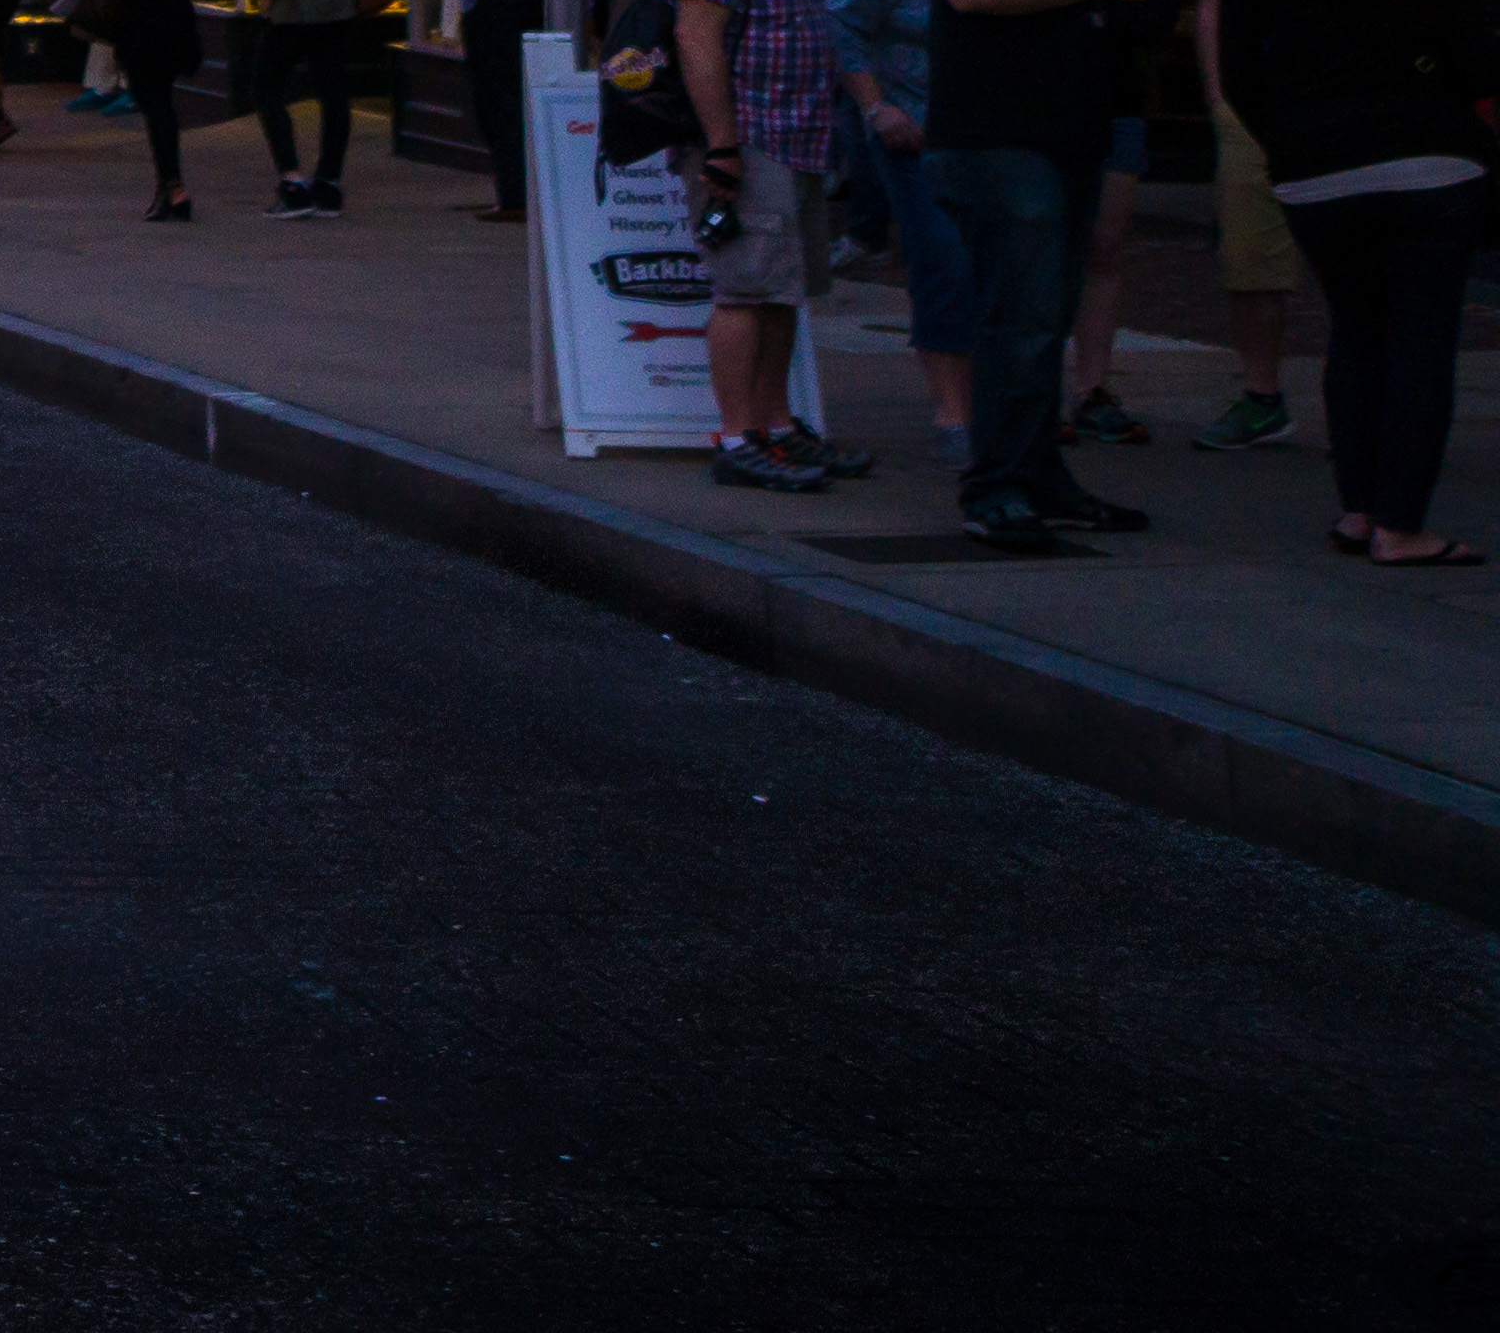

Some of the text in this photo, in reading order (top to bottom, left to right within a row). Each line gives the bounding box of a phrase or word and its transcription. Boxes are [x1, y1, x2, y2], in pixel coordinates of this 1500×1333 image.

[567, 120, 595, 134] Get
[613, 190, 664, 205] Ghost
[610, 217, 676, 237] History
